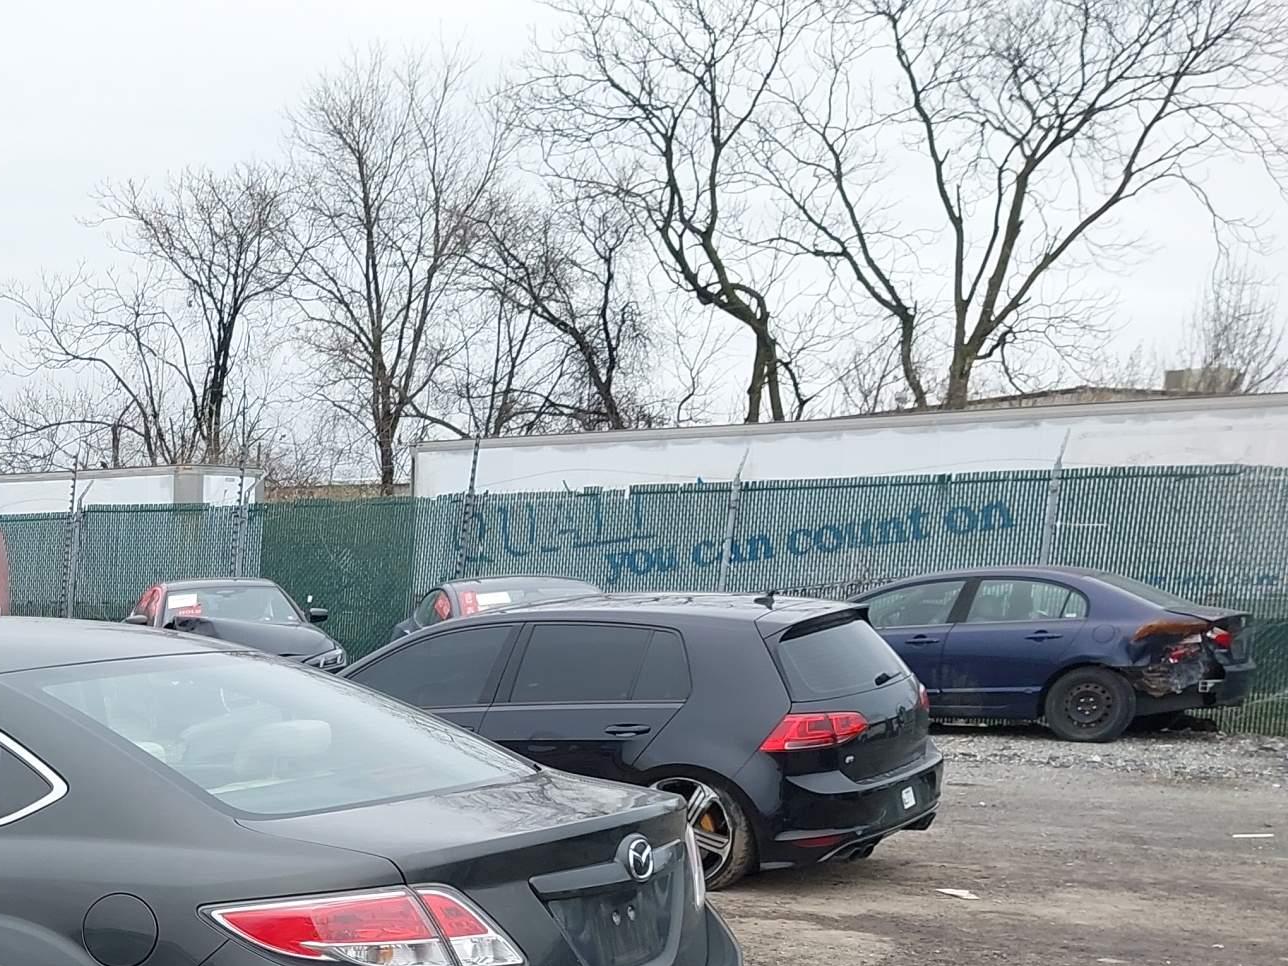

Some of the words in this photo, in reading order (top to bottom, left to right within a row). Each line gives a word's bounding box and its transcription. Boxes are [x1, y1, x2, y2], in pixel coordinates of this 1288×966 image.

[606, 546, 678, 585] you
[692, 533, 774, 567] can
[787, 508, 930, 556] count
[946, 500, 1016, 535] on
